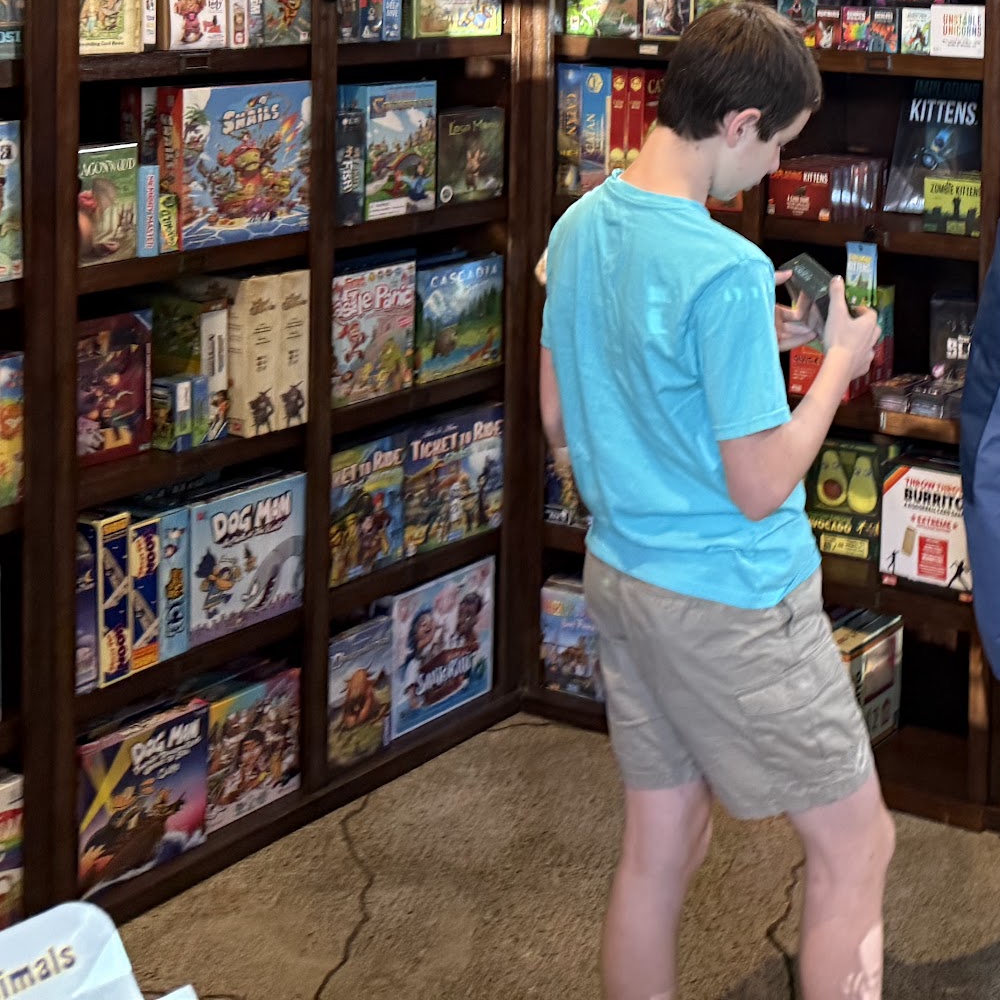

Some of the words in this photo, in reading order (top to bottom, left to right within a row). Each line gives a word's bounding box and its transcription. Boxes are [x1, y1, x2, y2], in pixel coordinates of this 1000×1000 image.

[909, 98, 977, 125] KITTENS
[586, 113, 597, 155] CATAN
[80, 157, 137, 179] AGONWOOD
[803, 171, 829, 184] KITTENS
[955, 184, 980, 197] KITTEN
[430, 264, 498, 289] CASCADIA
[411, 432, 459, 462] TICKET
[472, 418, 504, 441] RIDE
[332, 463, 357, 488] KET
[372, 447, 403, 472] RIDE
[211, 502, 254, 544] DOG
[254, 490, 293, 526] MAN
[810, 517, 852, 534] VOCADO
